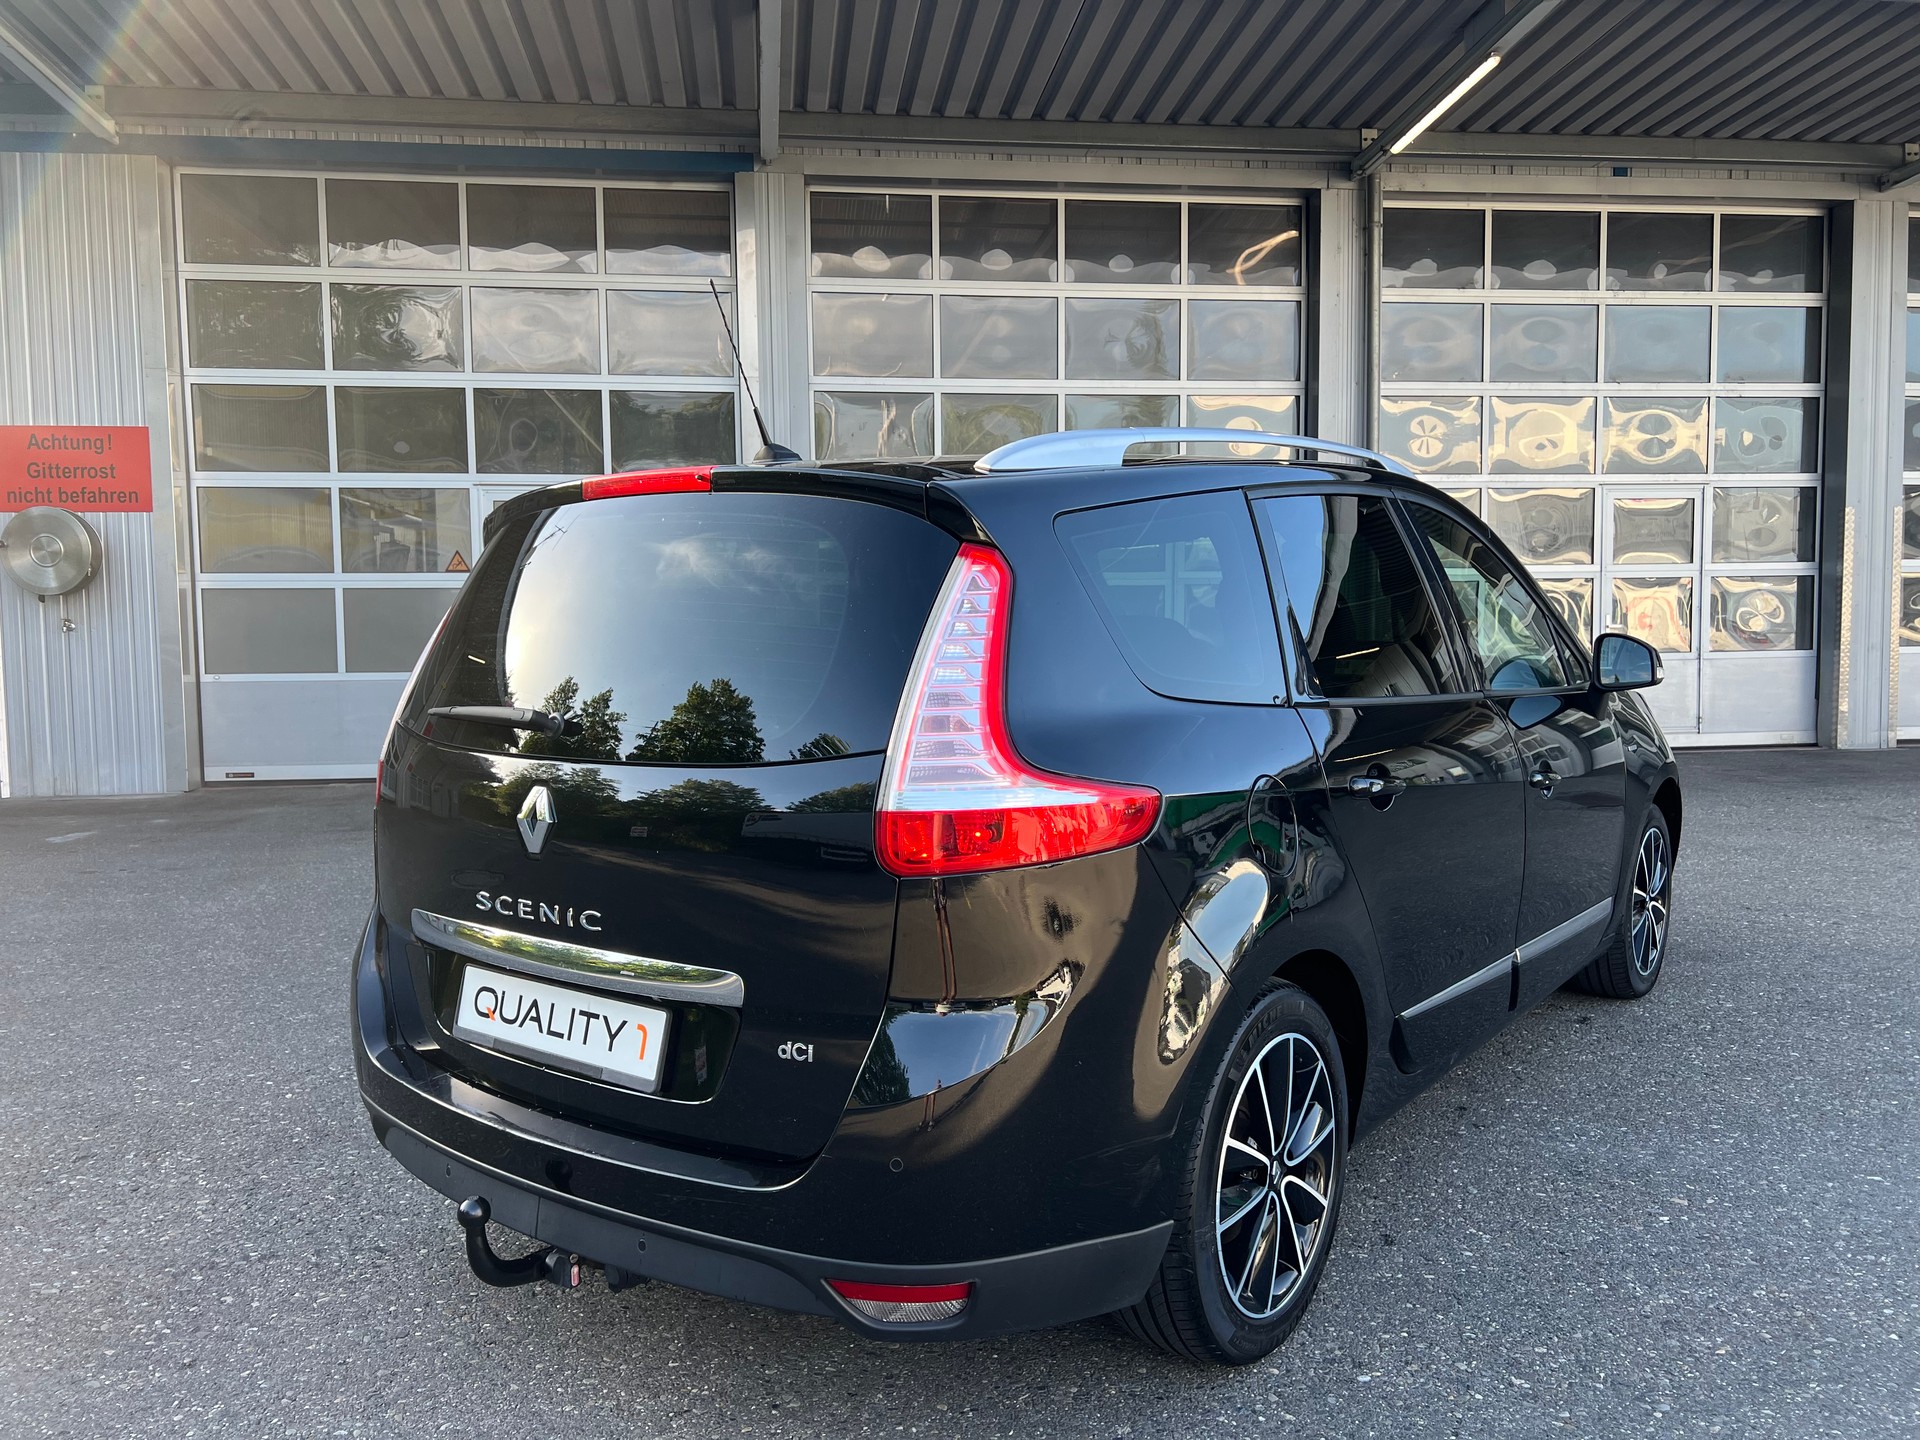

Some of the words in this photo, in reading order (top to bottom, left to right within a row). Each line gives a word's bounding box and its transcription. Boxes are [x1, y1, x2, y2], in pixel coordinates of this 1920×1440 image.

[27, 433, 112, 454] Achtung!
[27, 462, 116, 479] Gitterrost
[7, 487, 52, 503] nicht
[58, 487, 139, 503] befahren
[476, 891, 602, 931] SCENIC
